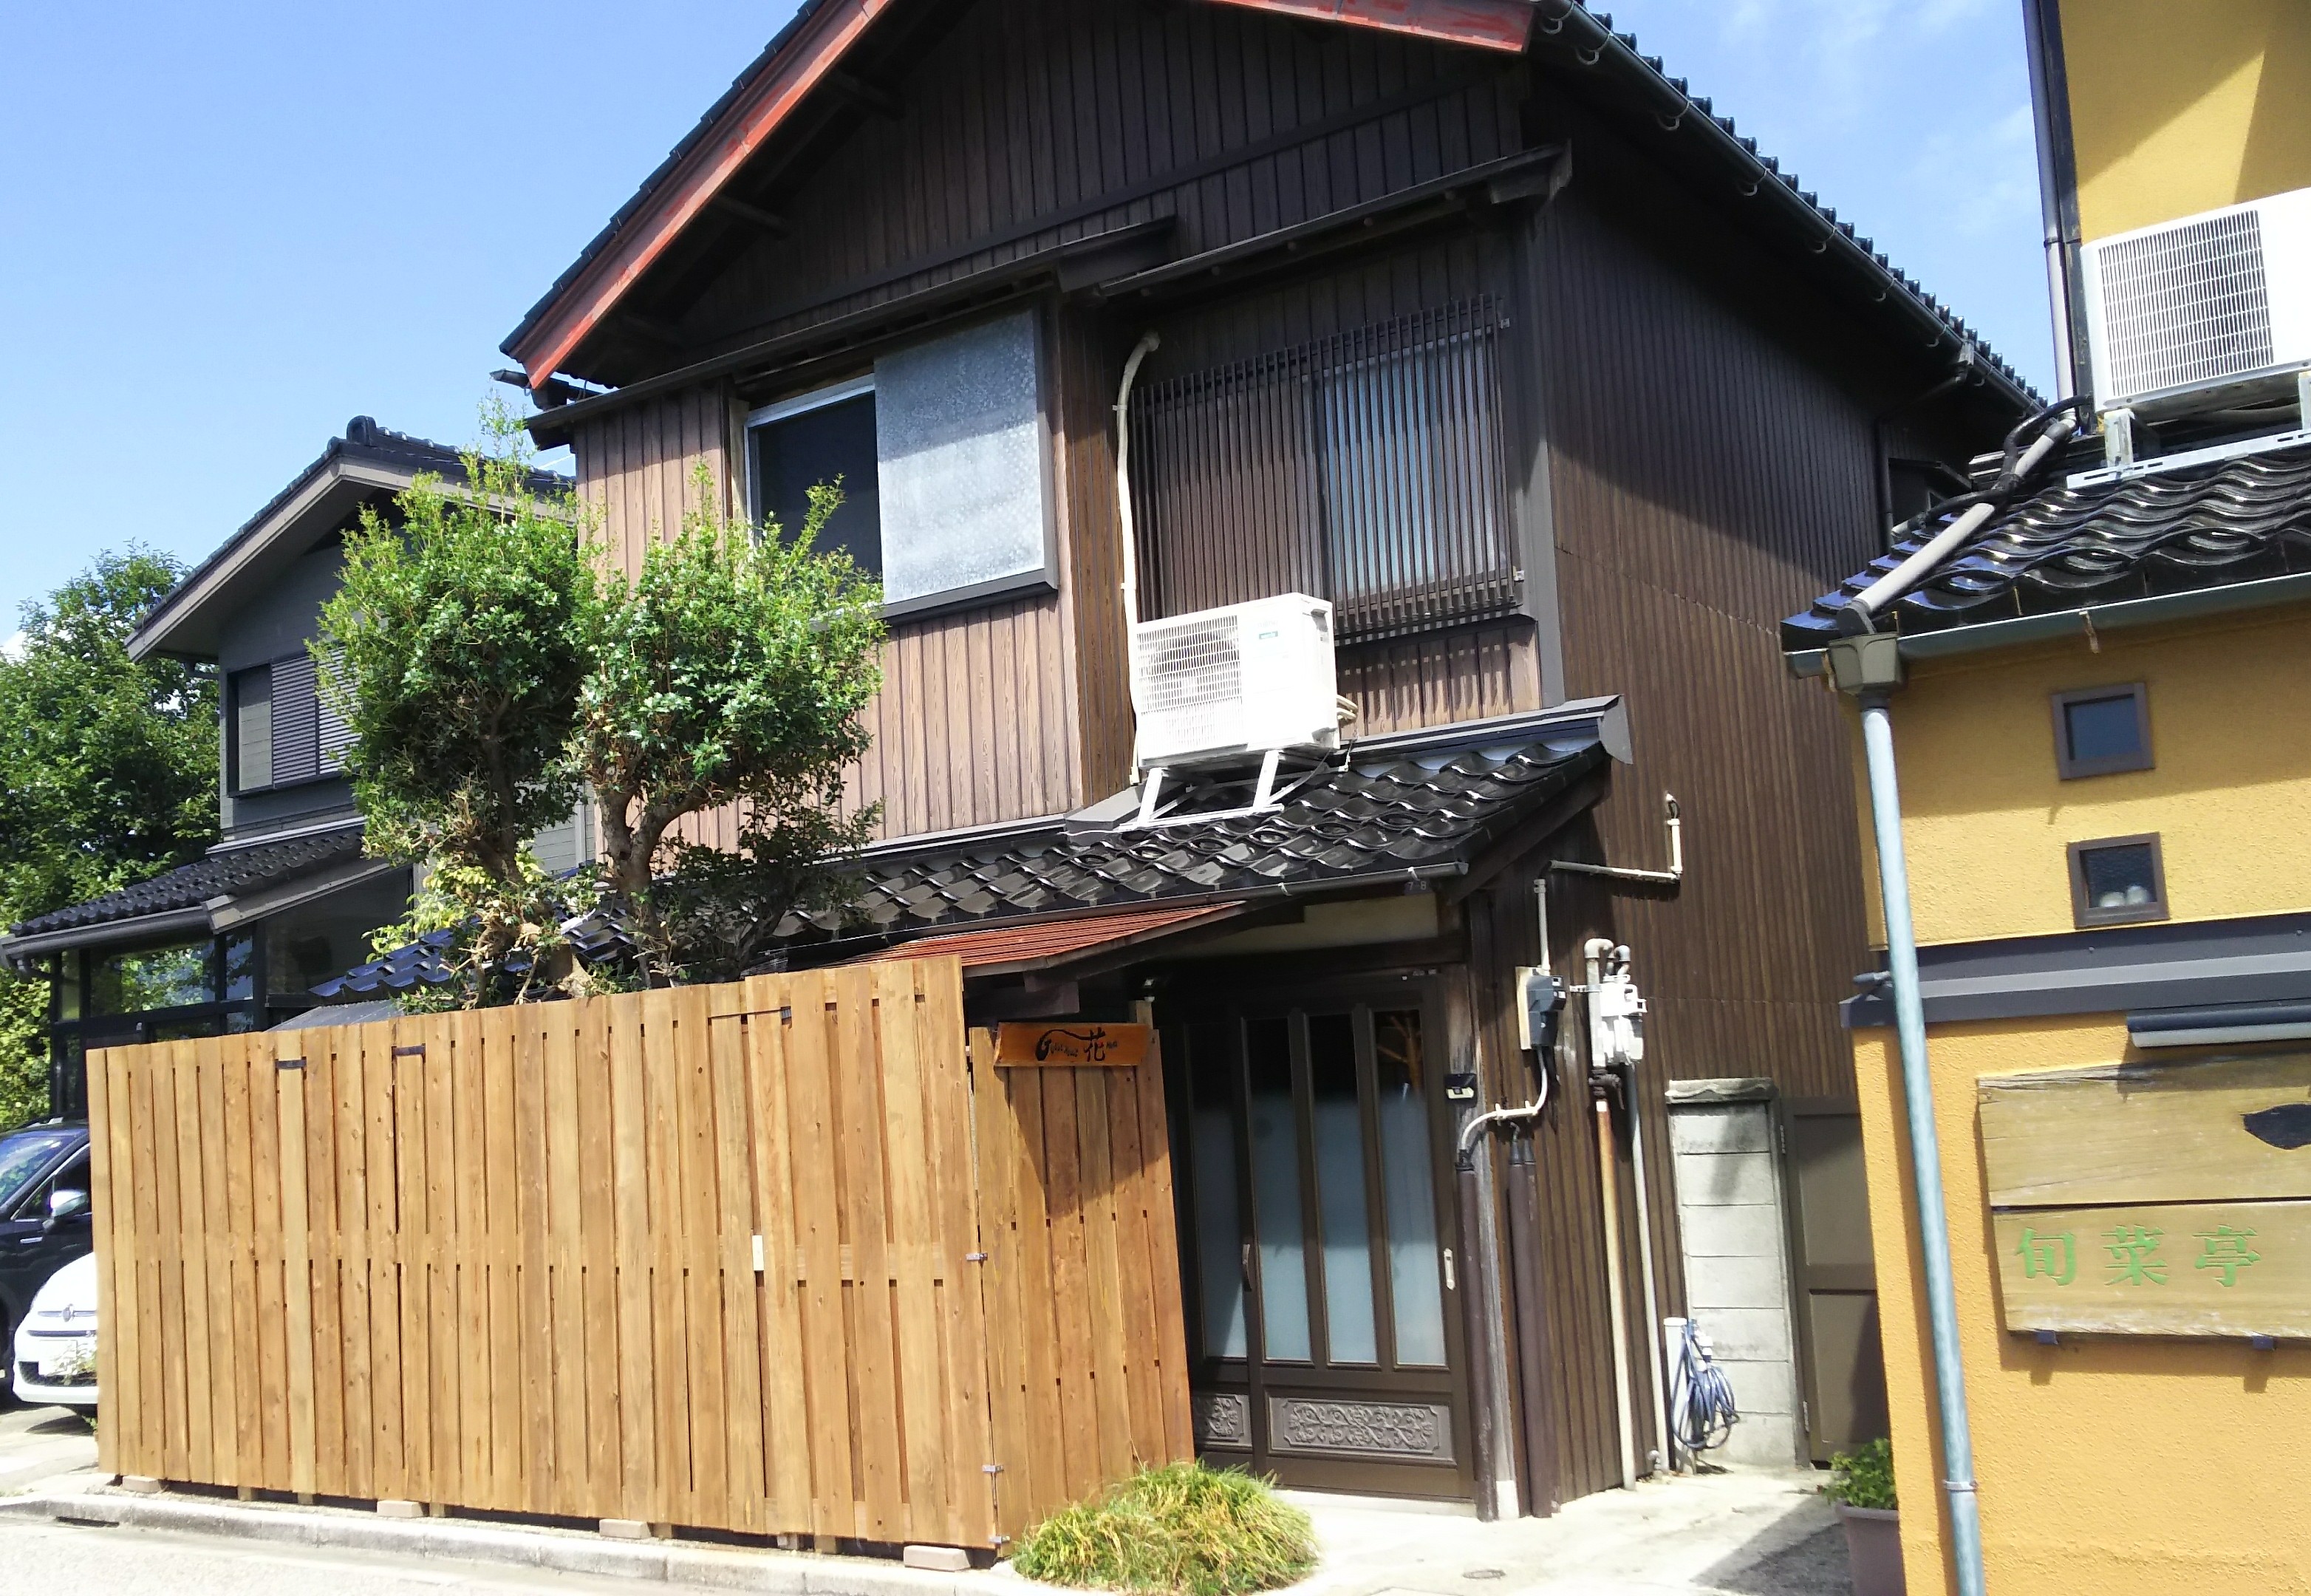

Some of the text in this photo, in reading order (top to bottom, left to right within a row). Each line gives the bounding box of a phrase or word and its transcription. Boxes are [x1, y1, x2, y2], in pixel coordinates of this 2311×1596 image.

[1084, 1027, 1106, 1062] 花
[2015, 1224, 2261, 1287] 旬菜亭
